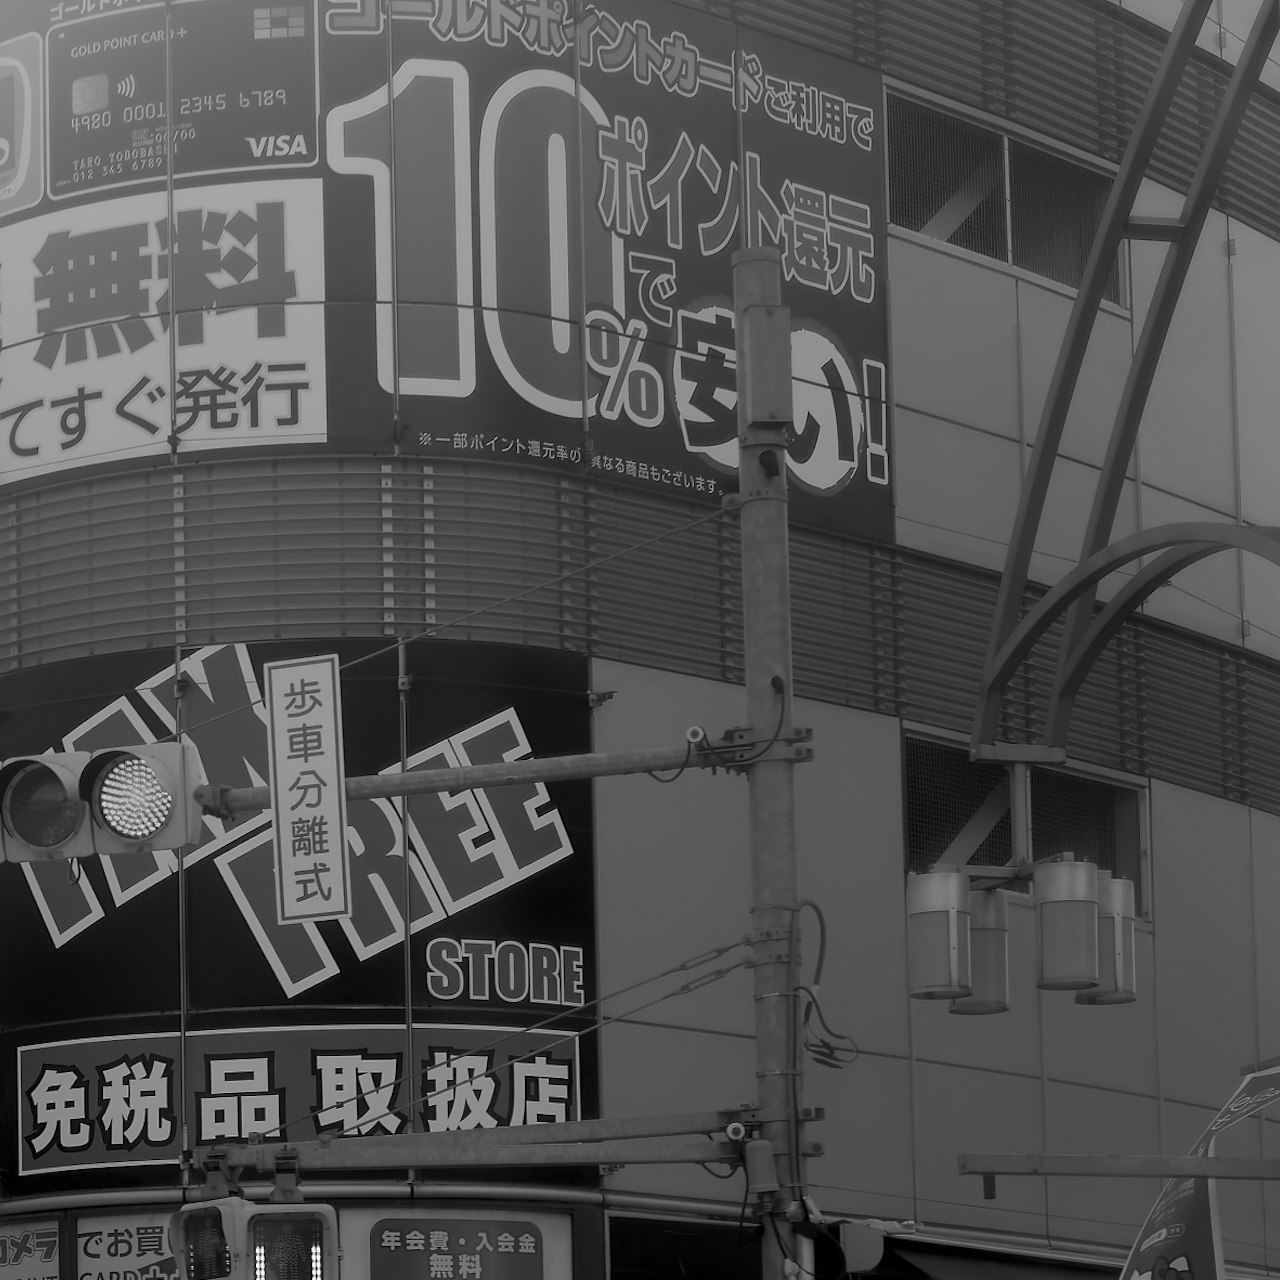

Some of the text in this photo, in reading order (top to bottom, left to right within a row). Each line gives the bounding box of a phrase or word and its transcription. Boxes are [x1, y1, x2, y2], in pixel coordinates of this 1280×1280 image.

[71, 42, 101, 58] GOLD
[103, 34, 138, 52] POINT
[71, 88, 287, 133] 4980 0001 2345 6789
[109, 145, 179, 164] YODOBASI
[131, 157, 163, 171] 6789
[244, 134, 308, 158] VISA
[33, 200, 297, 369] 無料
[282, 675, 333, 905] 歩車分離式
[213, 706, 574, 999] FREE
[425, 936, 585, 1007] STORE
[28, 1052, 571, 1154] 免税品取扱店
[380, 1229, 537, 1254] 年会費・入会金
[427, 1252, 483, 1280] 無料
